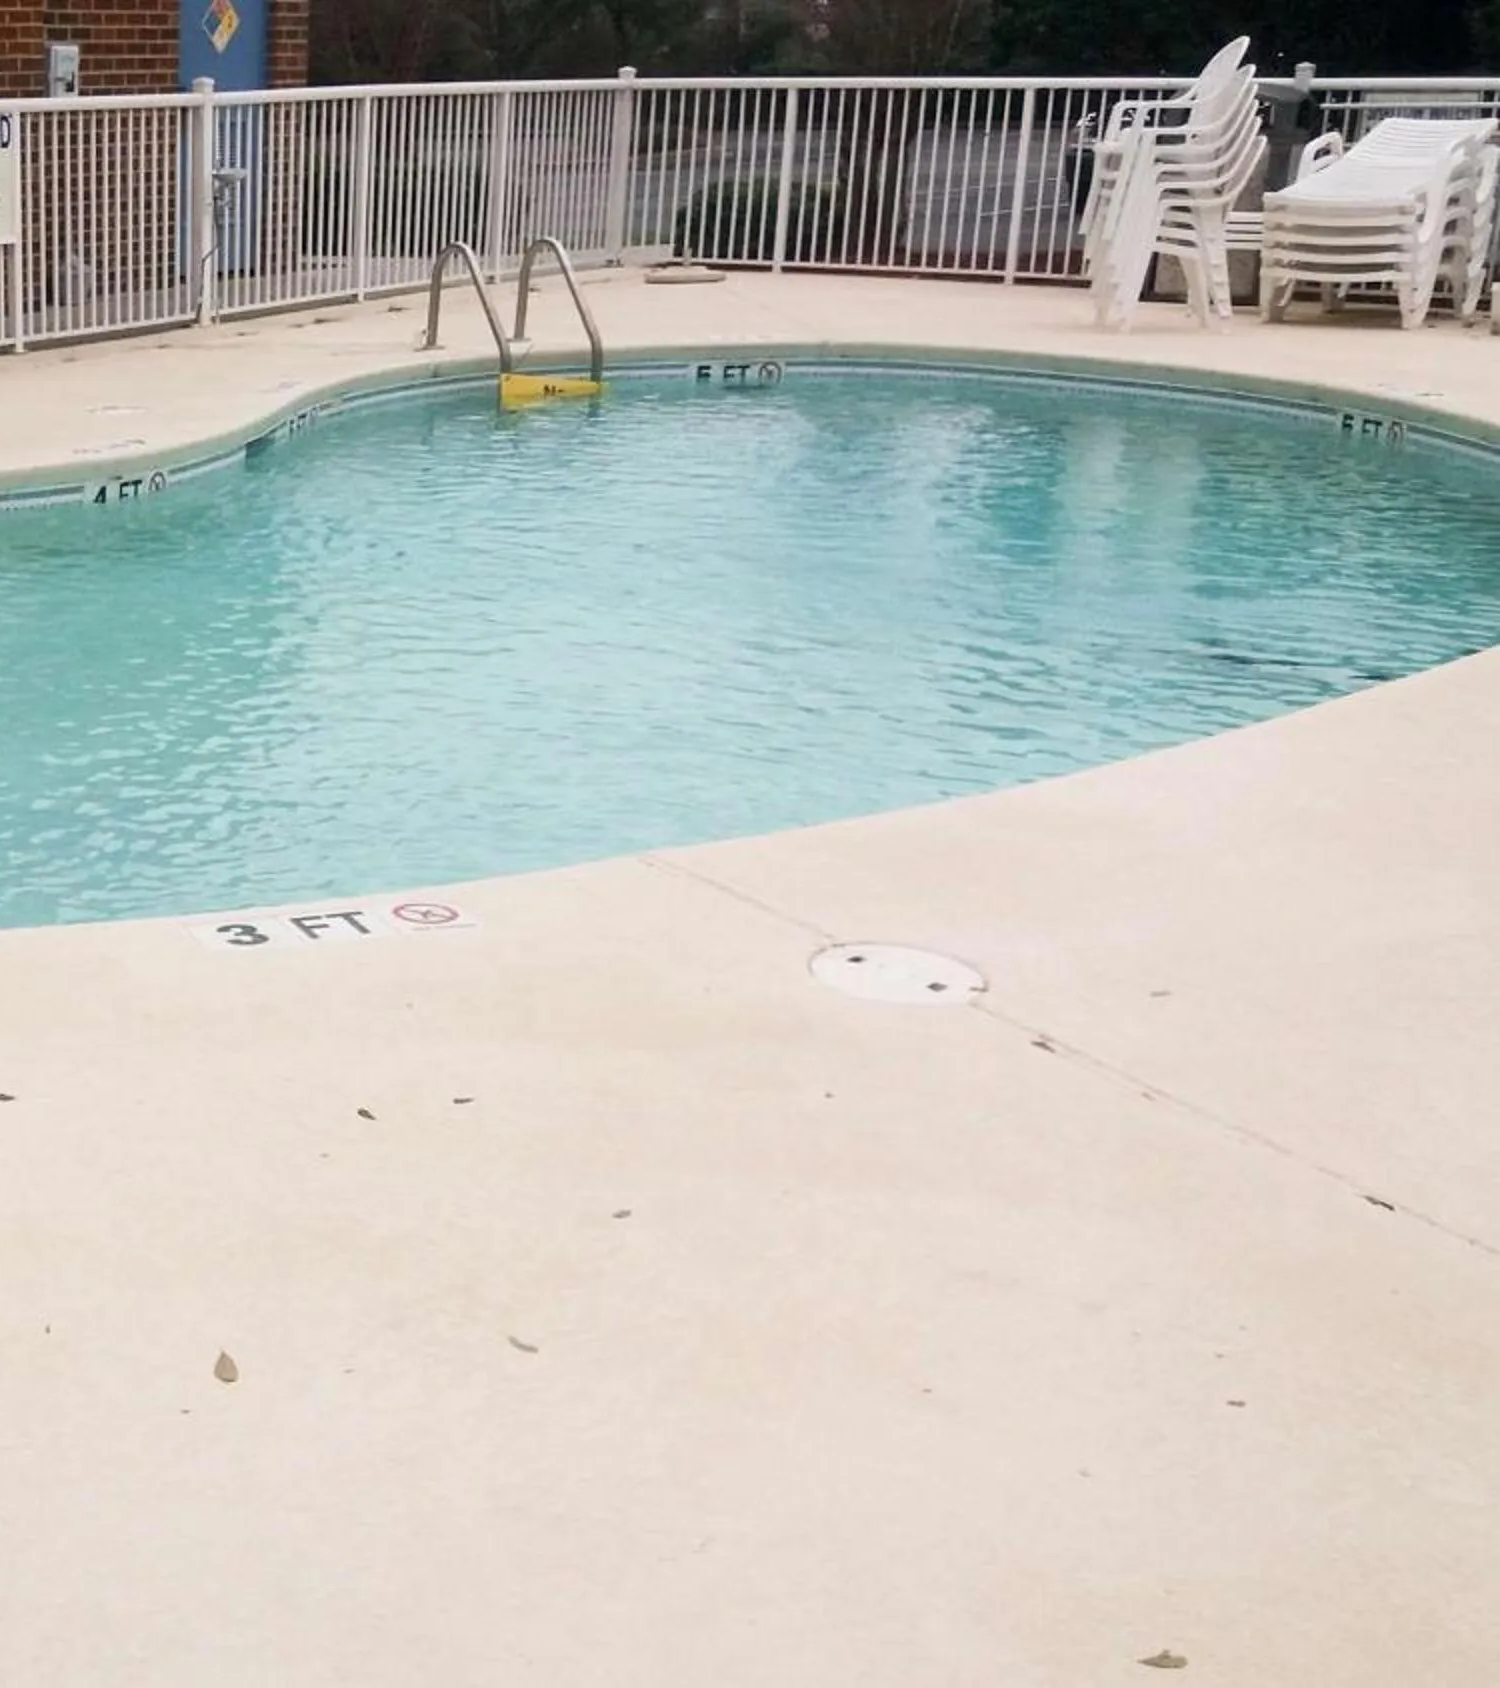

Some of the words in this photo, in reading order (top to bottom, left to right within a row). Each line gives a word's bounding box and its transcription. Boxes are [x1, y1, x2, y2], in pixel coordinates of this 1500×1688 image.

[723, 365, 750, 379] FT
[1363, 418, 1383, 437] FT
[120, 479, 142, 499] FT
[216, 924, 269, 945] 3
[290, 911, 371, 939] FT
